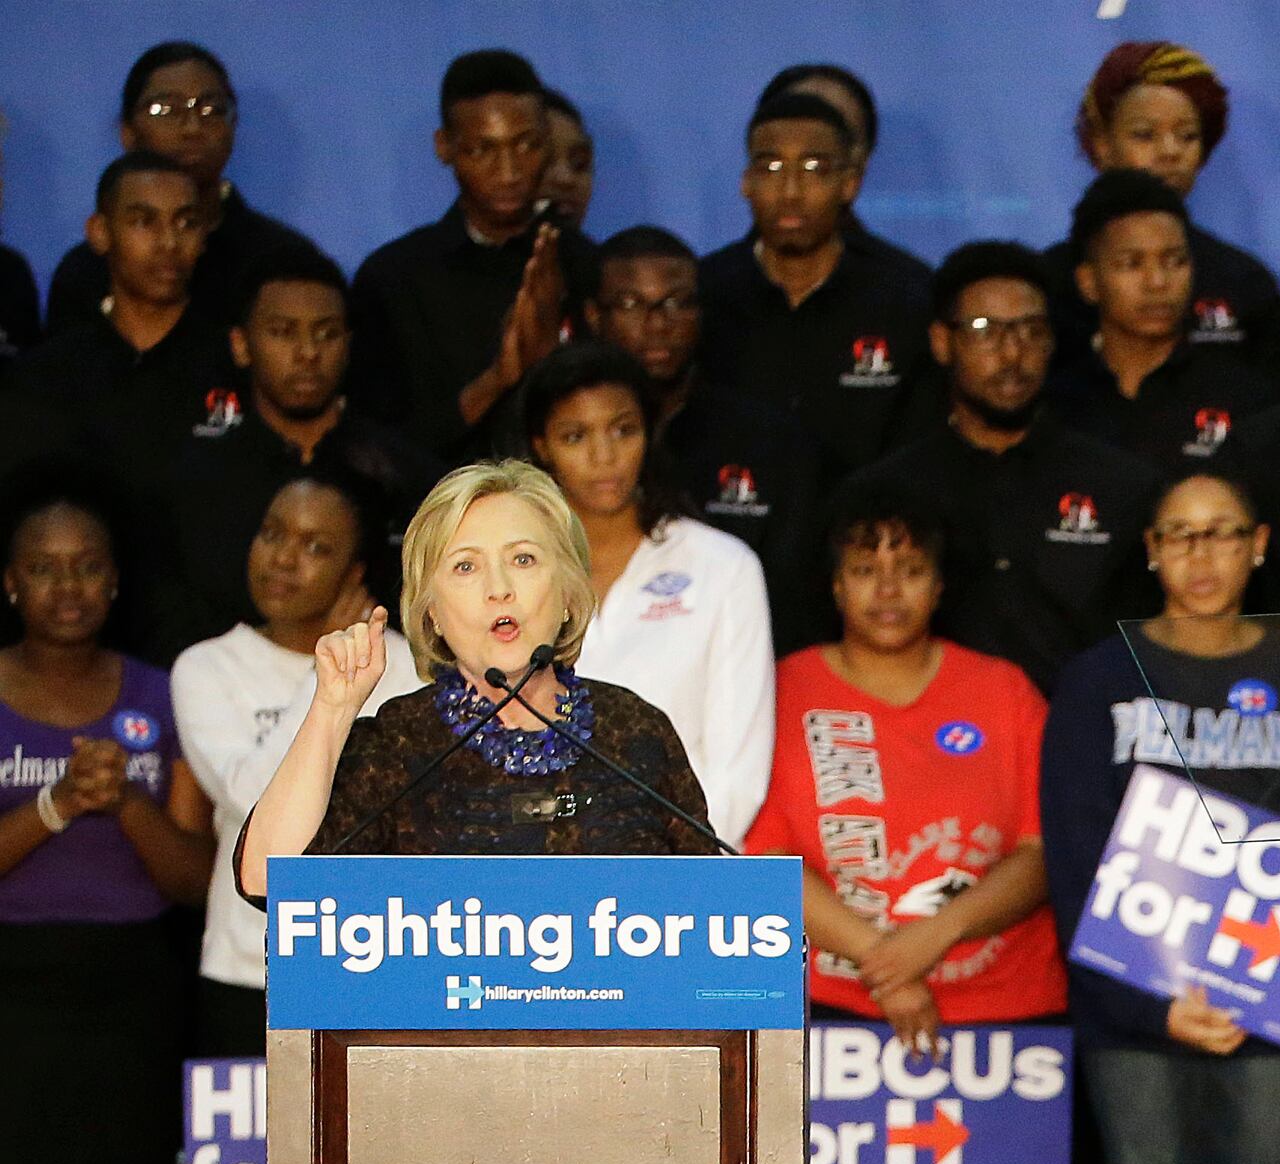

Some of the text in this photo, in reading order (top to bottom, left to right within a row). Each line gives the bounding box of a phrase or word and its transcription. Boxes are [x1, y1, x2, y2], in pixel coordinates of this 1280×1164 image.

[276, 896, 791, 974] Fighting for us
[1091, 851, 1212, 949] for
[485, 986, 625, 1004] hillaryclinton.com
[810, 1028, 1066, 1101] BCUs
